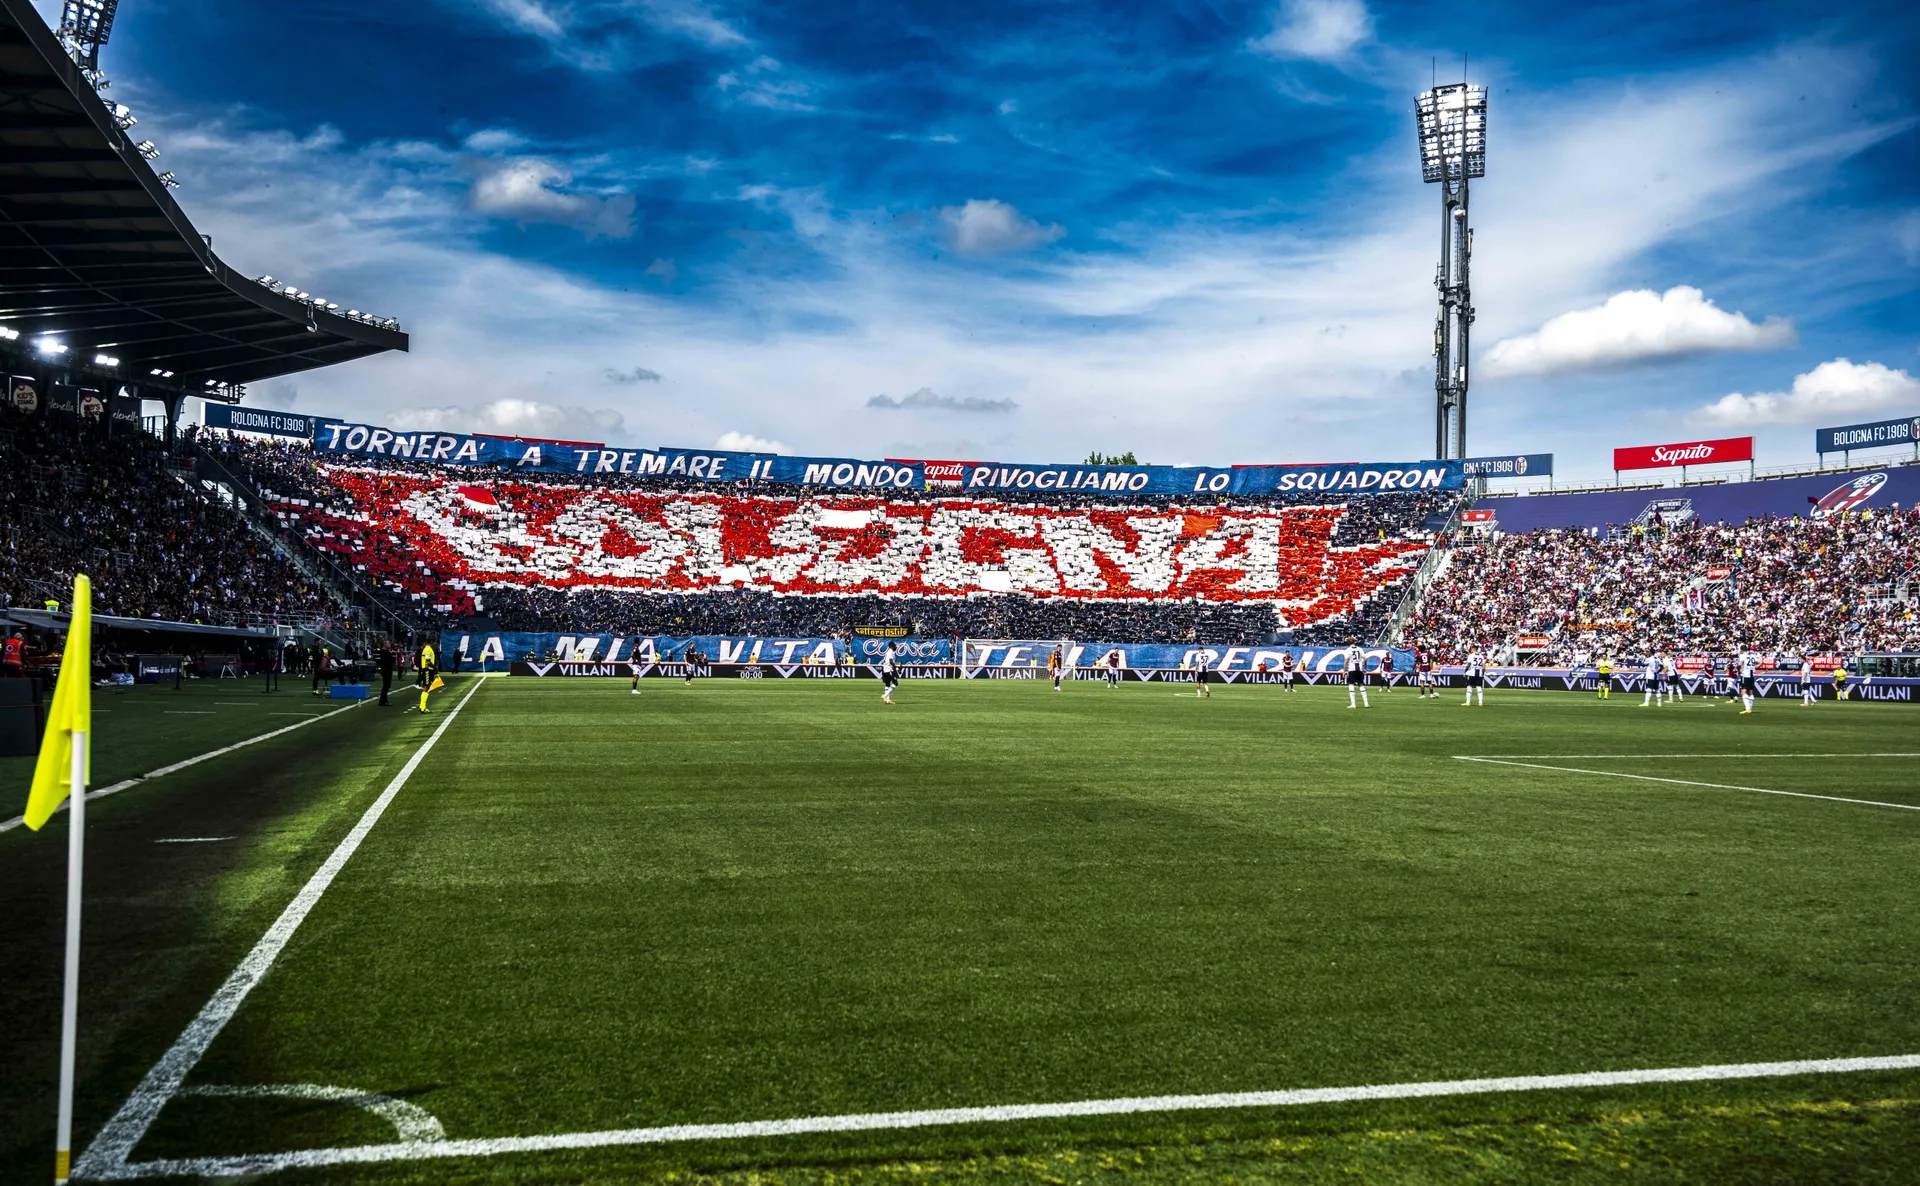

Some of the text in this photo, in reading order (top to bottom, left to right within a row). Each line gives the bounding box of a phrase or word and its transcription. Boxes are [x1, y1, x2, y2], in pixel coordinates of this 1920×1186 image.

[231, 410, 304, 432] BOLOGNA FC 1909
[1833, 423, 1909, 446] BOLOGNA FC 1909
[1651, 443, 1715, 465] Saputo
[516, 445, 542, 467] A
[573, 450, 727, 479] TREMARE
[749, 458, 775, 481] IL
[802, 463, 914, 488] MONDO
[968, 466, 1149, 491] RIVOGLIAMO
[1193, 472, 1230, 492] LO
[1277, 467, 1447, 492] SQUADRON
[1492, 460, 1513, 473] 1909
[459, 635, 505, 662] LA
[719, 639, 836, 664] VITA
[1351, 650, 1360, 661] 31
[1421, 655, 1428, 663] 9
[1473, 657, 1483, 667] 32
[1746, 656, 1755, 667] 29
[559, 664, 616, 676] VILLANI
[740, 671, 763, 679] 00:00
[803, 666, 856, 678] VILLANI
[986, 668, 1036, 680] VILLANI
[1507, 677, 1541, 688] VILLANI
[1859, 685, 1911, 700] VILLANI
